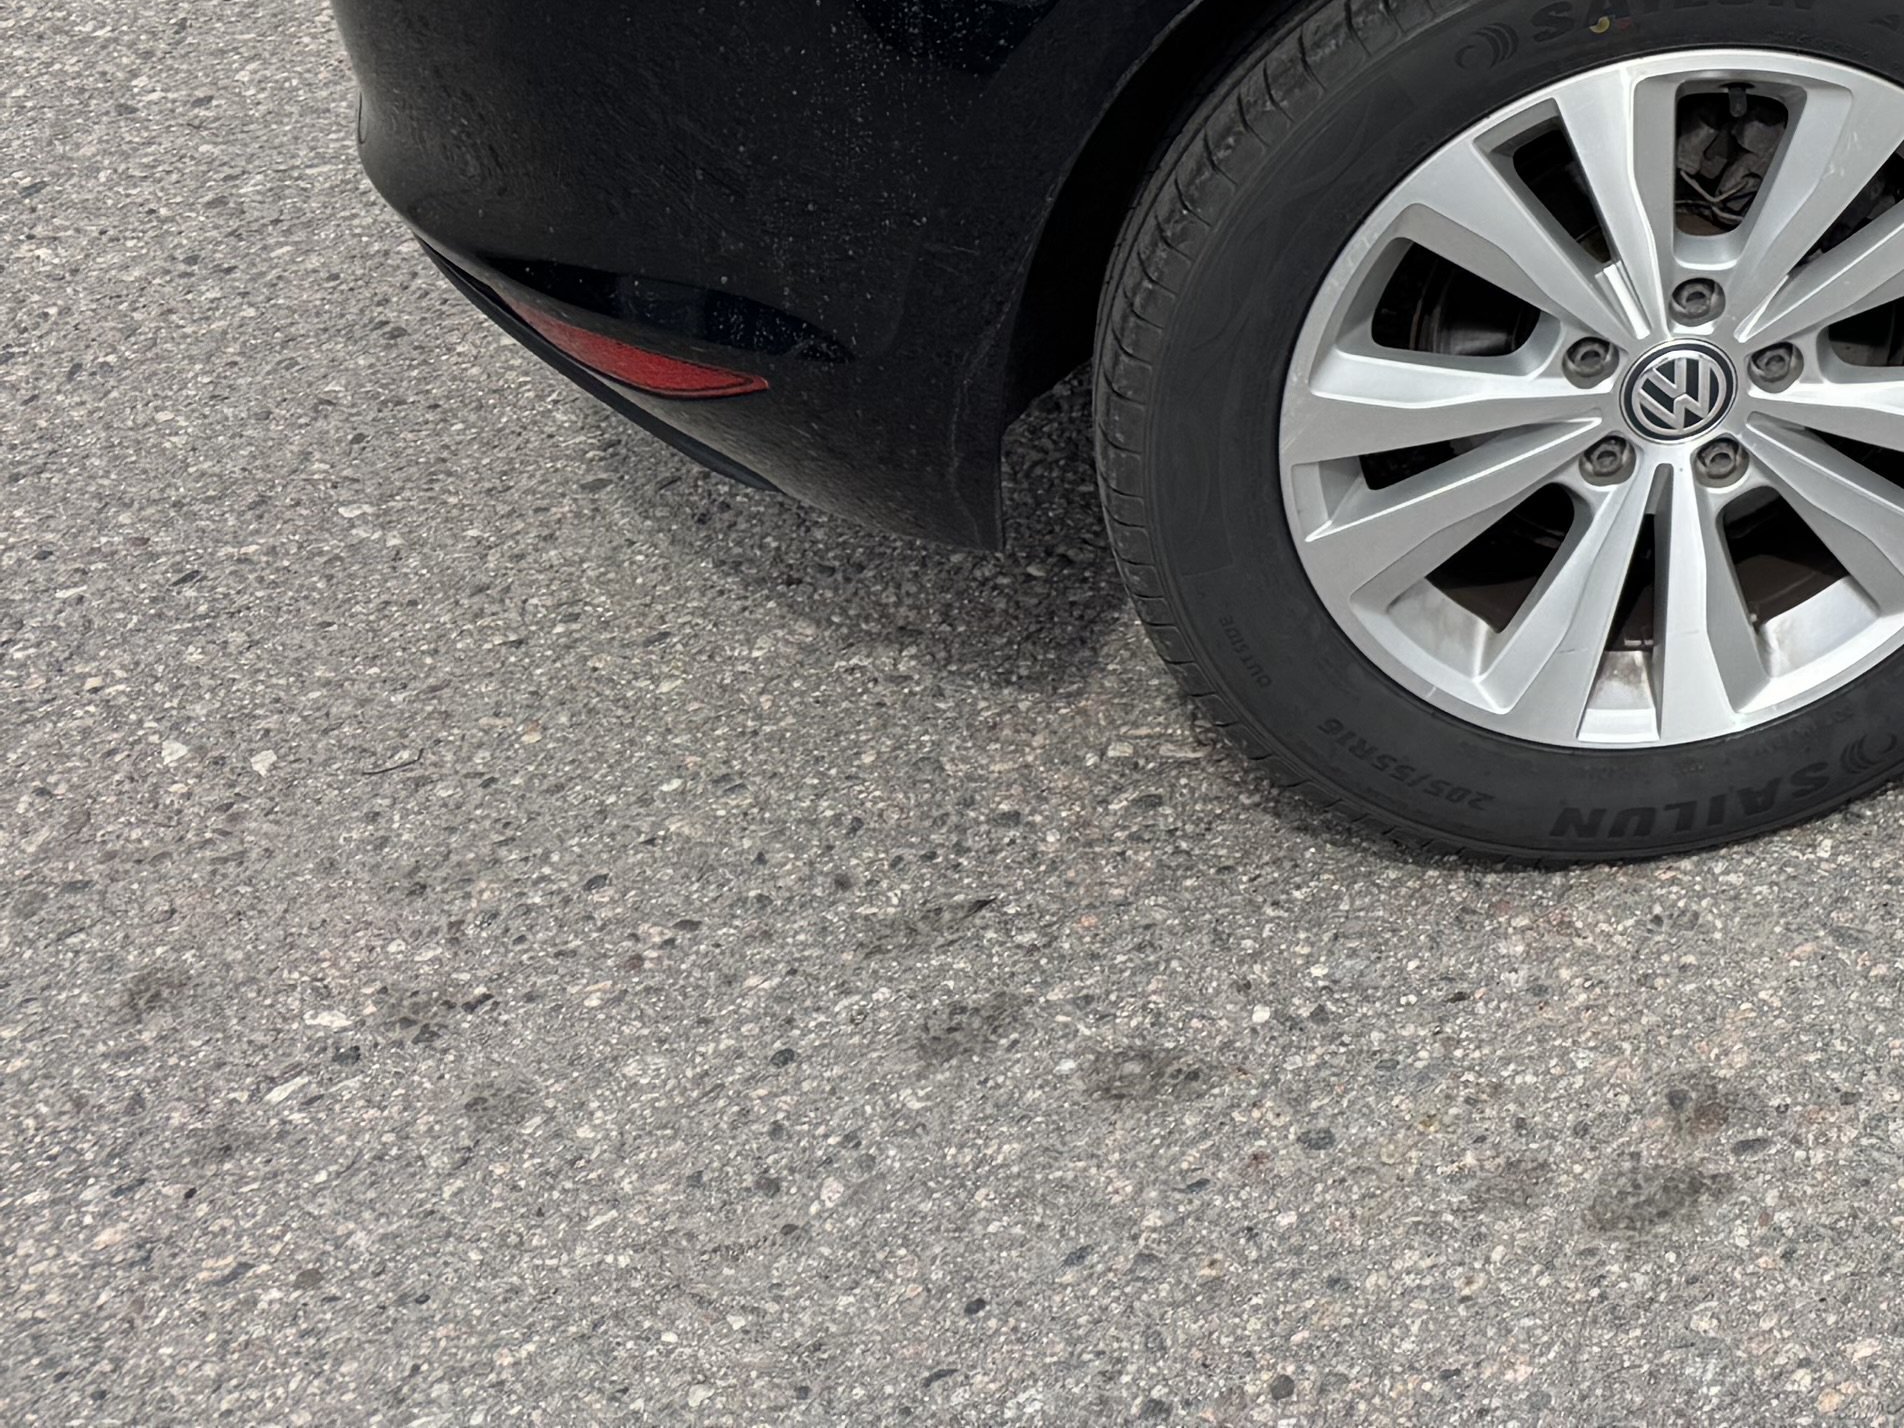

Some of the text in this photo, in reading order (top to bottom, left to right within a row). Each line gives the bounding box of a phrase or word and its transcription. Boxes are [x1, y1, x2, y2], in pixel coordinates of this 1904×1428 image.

[1630, 348, 1728, 437] VW
[1219, 615, 1272, 688] OUTSIDE
[1317, 718, 1495, 811] 205/55R16
[1549, 761, 1829, 838] SAILUN
